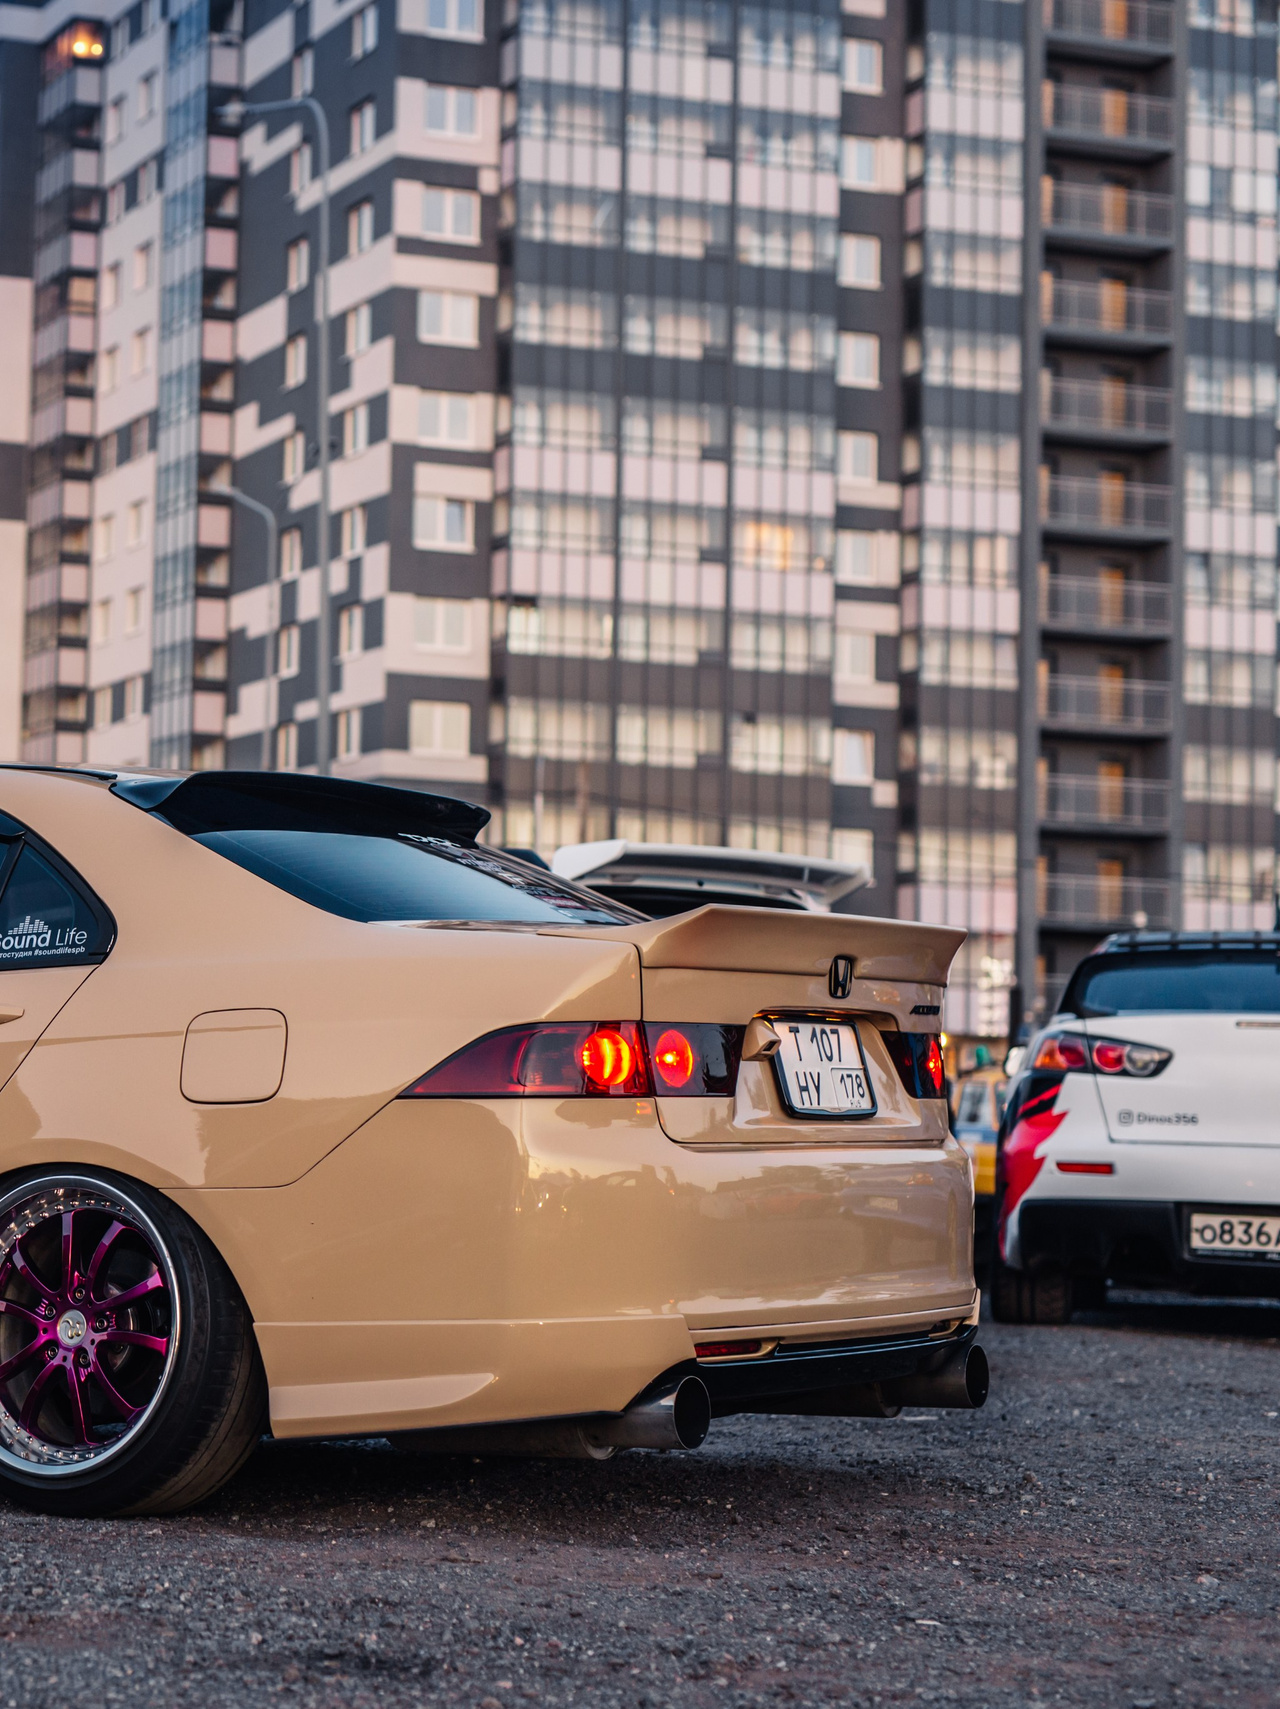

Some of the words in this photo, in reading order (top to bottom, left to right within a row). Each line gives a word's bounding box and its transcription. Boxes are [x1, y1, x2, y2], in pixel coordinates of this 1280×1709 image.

[55, 927, 88, 946] Life
[34, 946, 86, 956] #soundlifespb
[788, 1026, 802, 1062] T
[810, 1027, 842, 1062] 107
[840, 1073, 865, 1099] 178
